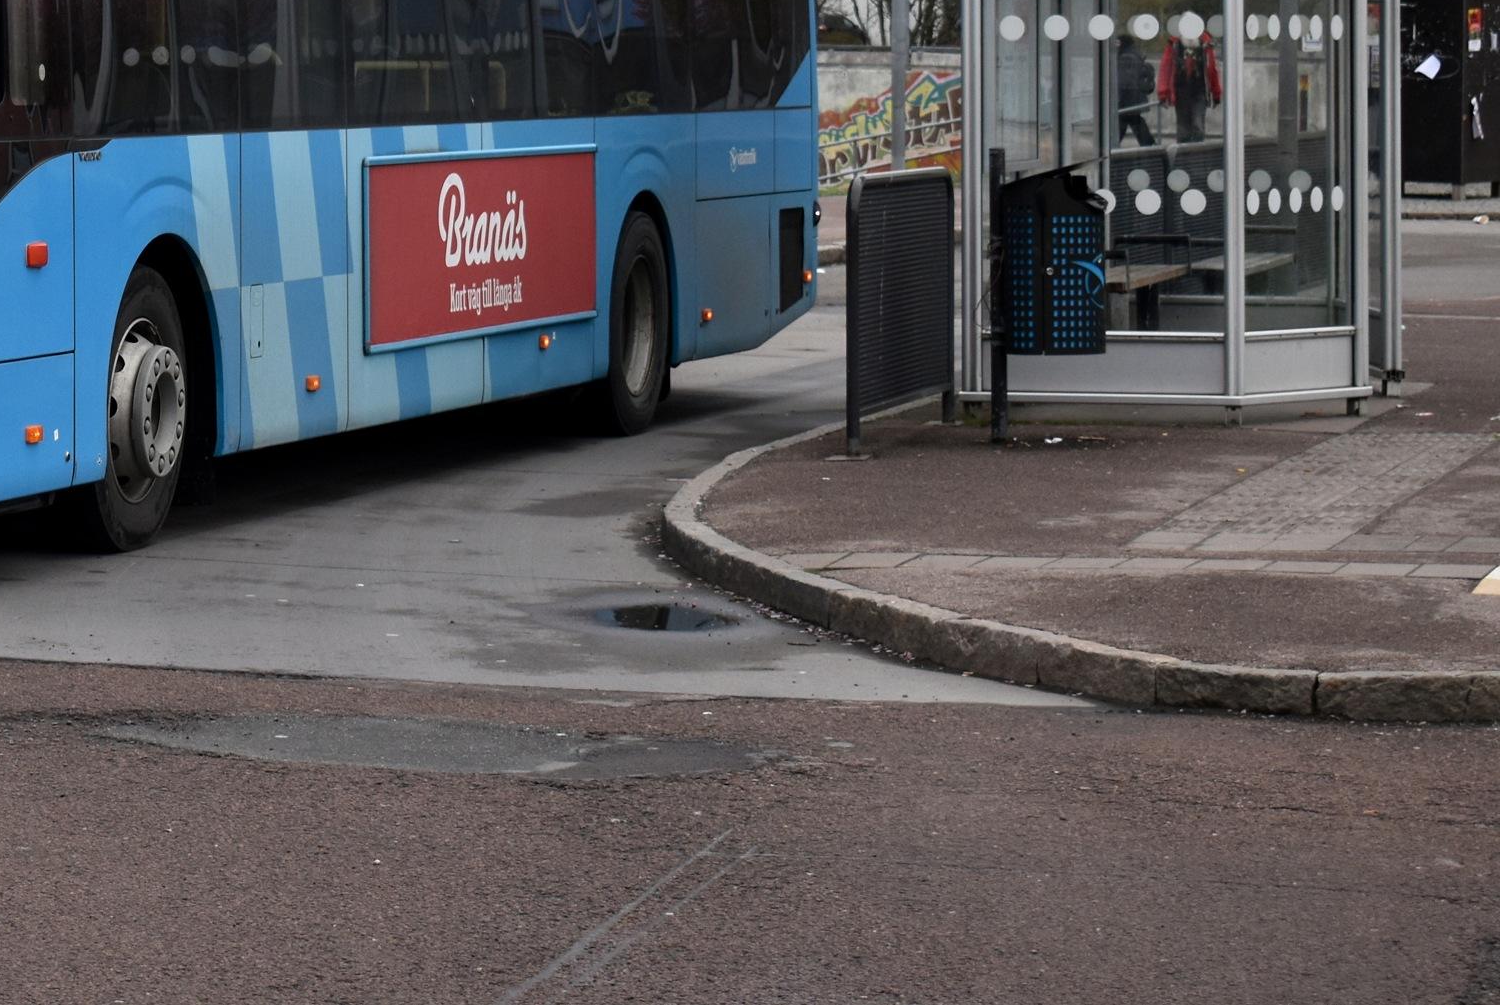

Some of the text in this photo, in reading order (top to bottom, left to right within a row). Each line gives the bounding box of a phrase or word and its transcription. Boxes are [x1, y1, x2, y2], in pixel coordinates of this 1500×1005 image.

[438, 172, 527, 268] Branäs
[449, 282, 467, 313] Kort
[482, 277, 493, 309] till
[492, 277, 514, 312] långa
